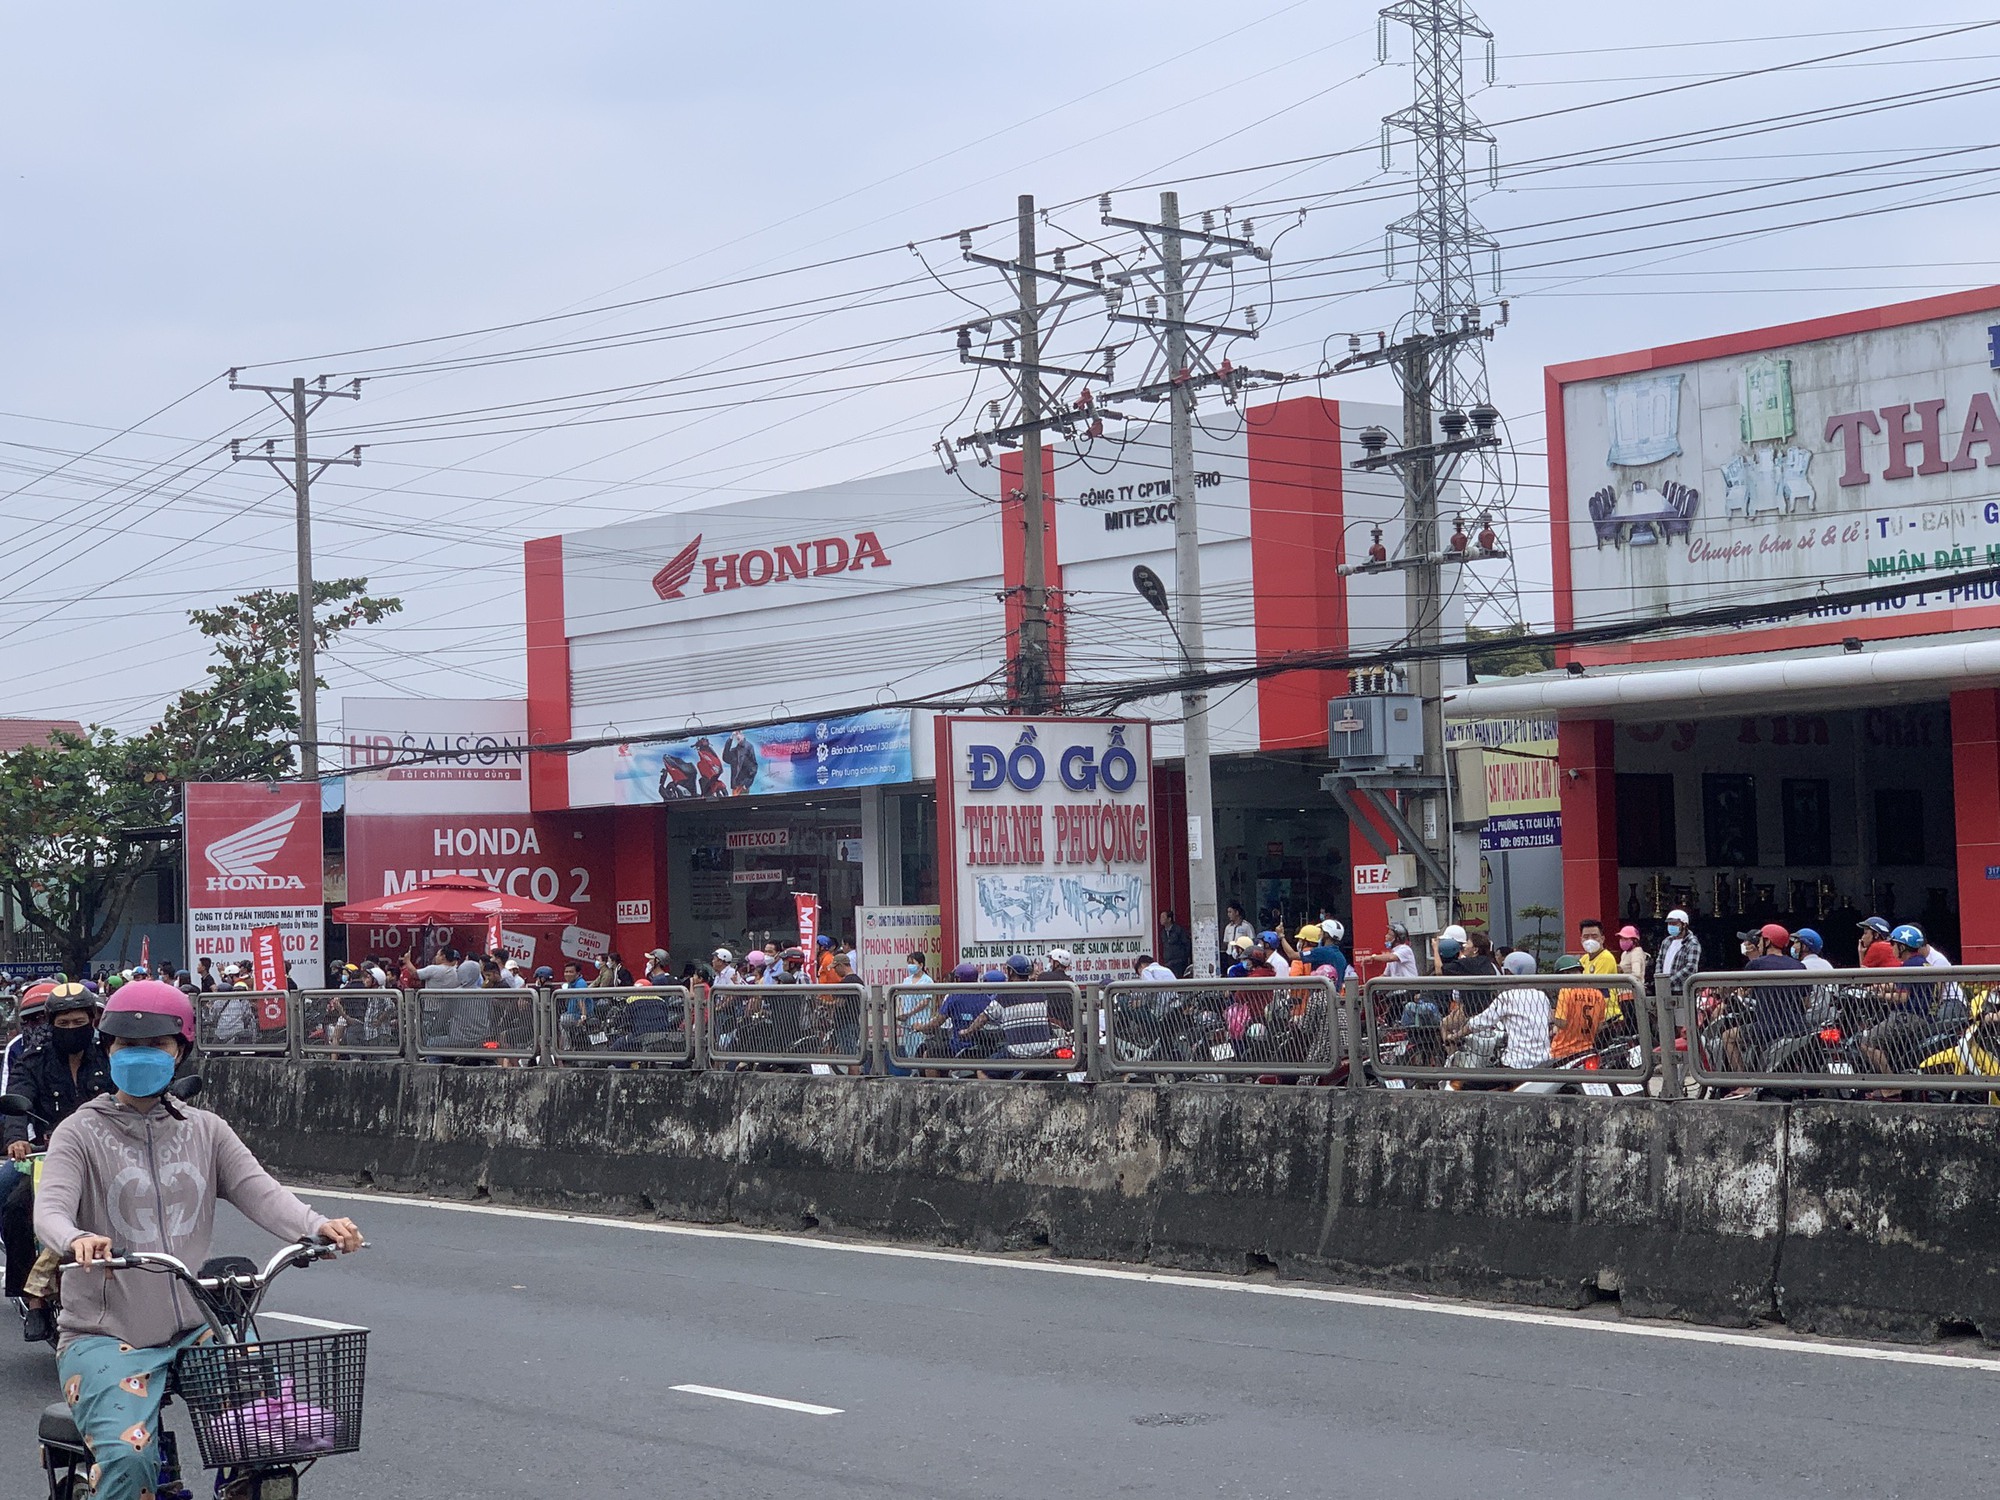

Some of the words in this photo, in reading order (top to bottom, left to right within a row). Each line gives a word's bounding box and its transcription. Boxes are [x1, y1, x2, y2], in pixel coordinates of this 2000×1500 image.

[1080, 488, 1114, 507] CÔNG
[1118, 485, 1134, 500] TY
[1138, 480, 1171, 498] CPTM
[702, 531, 892, 594] HONDA
[1688, 537, 1753, 564] Chuyên
[1759, 534, 1792, 554] bán
[1868, 548, 1926, 581] NHẬN
[1934, 543, 1977, 575] ĐẶT
[401, 736, 521, 766] SAISON
[967, 725, 1046, 791] ĐỒ
[1060, 725, 1137, 793] GỖ
[433, 827, 541, 857] HONDA
[729, 832, 776, 848] MITEXCO
[779, 831, 787, 844] 2
[962, 805, 1045, 865] THANH
[1052, 799, 1148, 875] PHƯỢNG
[206, 875, 305, 891] HONDA
[383, 866, 560, 904] MXCO
[569, 867, 591, 903] 2
[1357, 868, 1389, 884] HEA
[195, 911, 213, 921] CÔNG
[215, 912, 222, 920] TY
[224, 909, 232, 920] CỔ
[234, 909, 252, 920] PHẦN
[254, 910, 279, 919] THƯƠNG
[281, 910, 293, 920] MẠI
[295, 908, 304, 918] MỸ
[306, 910, 318, 918] THO
[619, 903, 649, 916] HEAD
[195, 937, 235, 954] HEAD
[310, 934, 318, 951] 2
[962, 943, 988, 959] CHUYÊN
[991, 942, 1005, 957] BÁN
[1073, 939, 1085, 954] GHẾ
[1088, 941, 1109, 954] SALON
[1111, 939, 1126, 953] CÁC
